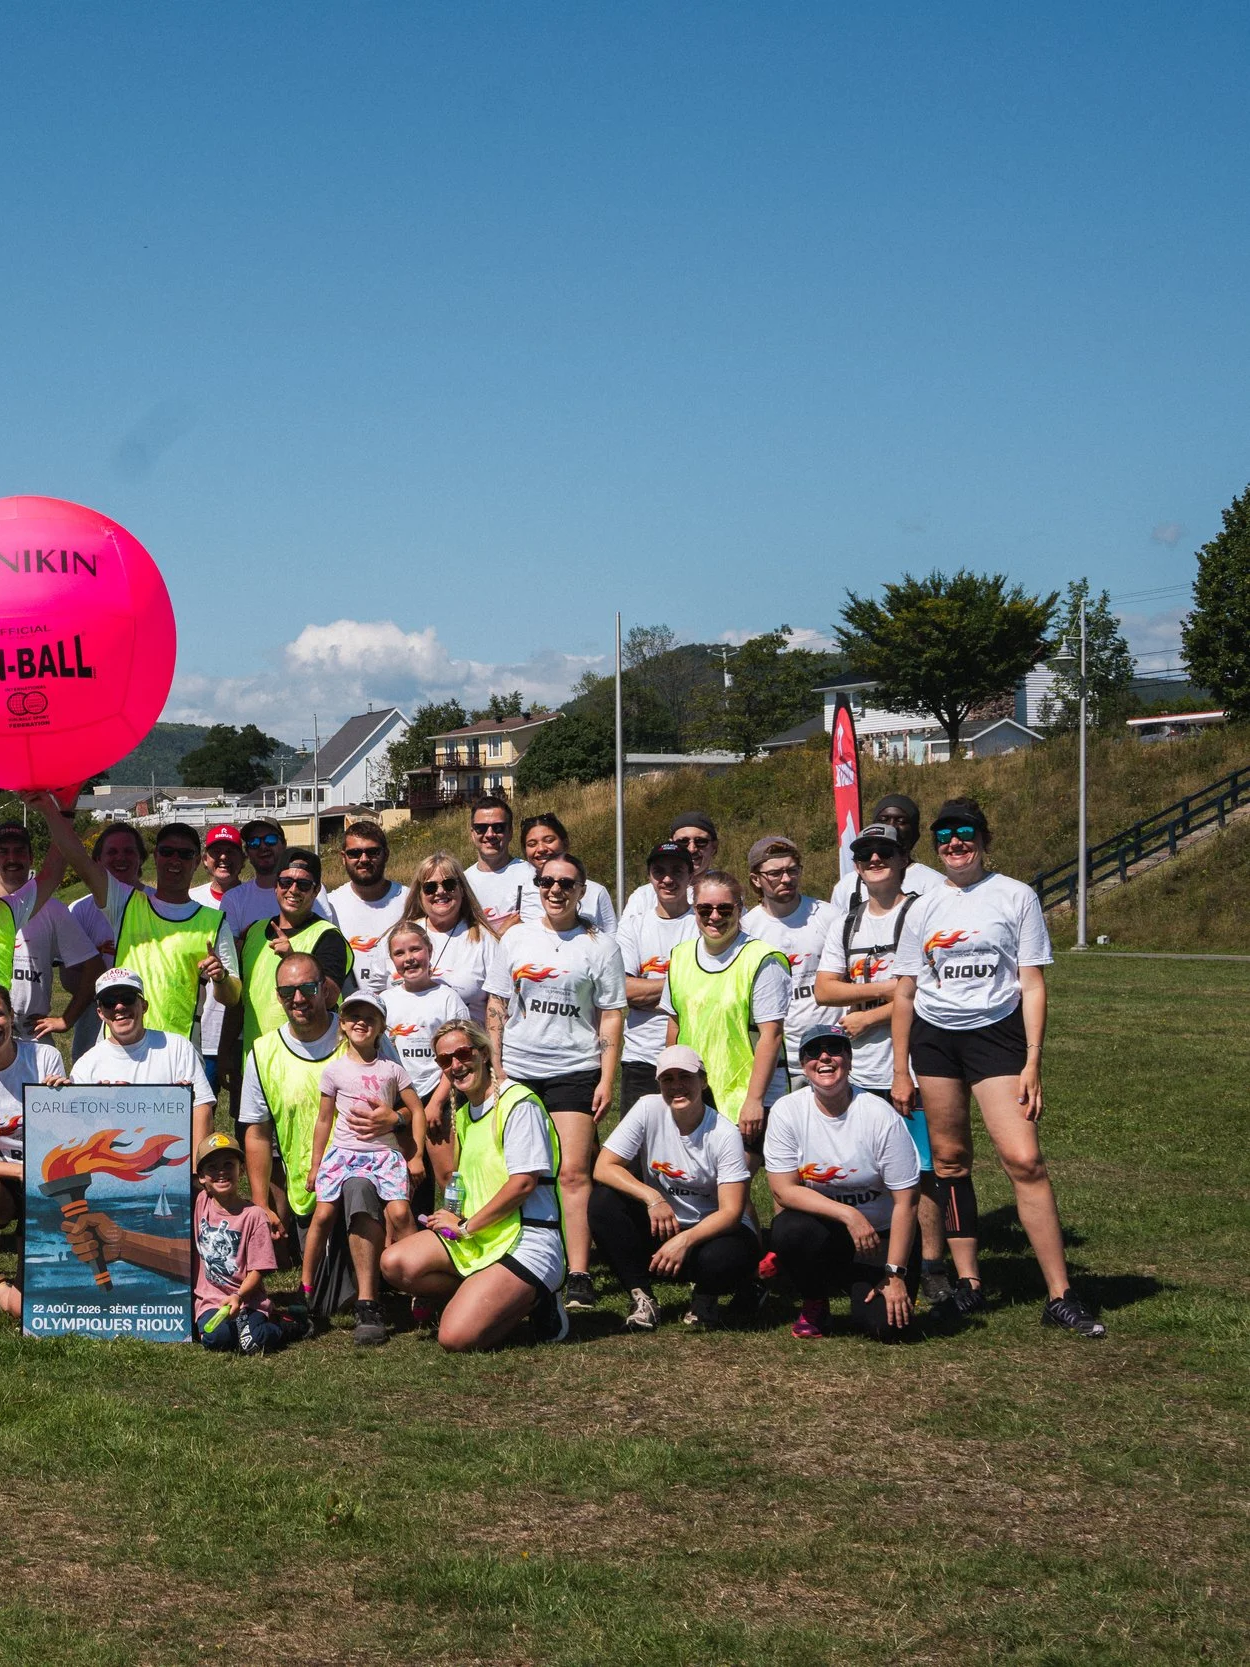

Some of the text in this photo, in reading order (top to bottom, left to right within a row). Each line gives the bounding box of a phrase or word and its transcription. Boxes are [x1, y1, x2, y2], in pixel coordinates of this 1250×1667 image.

[9, 721, 50, 729] FEDERATION
[14, 969, 43, 983] OUX
[944, 964, 999, 979] RIOUX
[530, 999, 581, 1018] RIOUX
[402, 1049, 435, 1058] RIOU
[31, 1101, 185, 1114] CARLETON-SUR-MER
[32, 1304, 44, 1314] 22
[46, 1302, 75, 1314] AOÛT
[76, 1304, 101, 1314] 2026
[109, 1303, 138, 1314] 3ÈME
[140, 1303, 183, 1315] ÉDITION
[31, 1317, 185, 1332] OLYMPIQUES RIOUX
